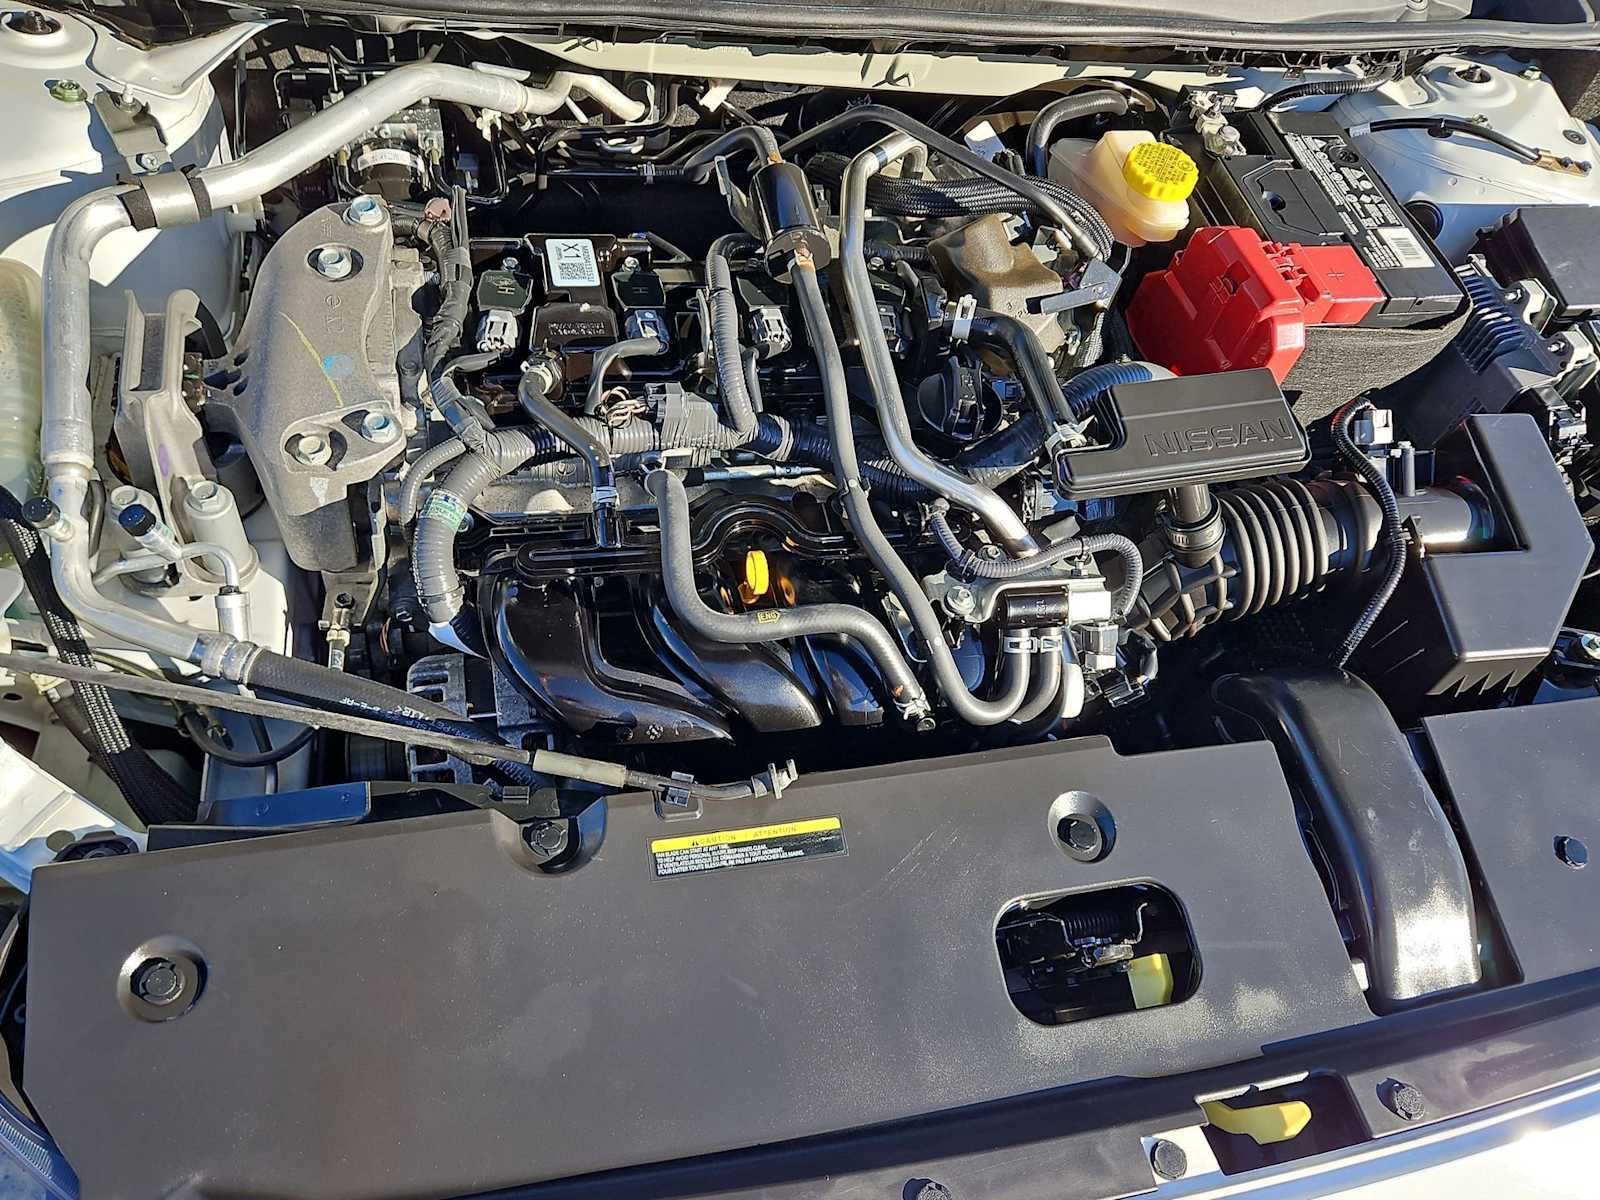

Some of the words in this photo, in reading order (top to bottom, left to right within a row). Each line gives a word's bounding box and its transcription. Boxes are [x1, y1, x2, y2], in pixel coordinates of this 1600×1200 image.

[561, 243, 581, 258] X1
[1144, 417, 1293, 457] NISSAN
[698, 834, 736, 843] CAUTION
[752, 827, 797, 837] ATTENTION
